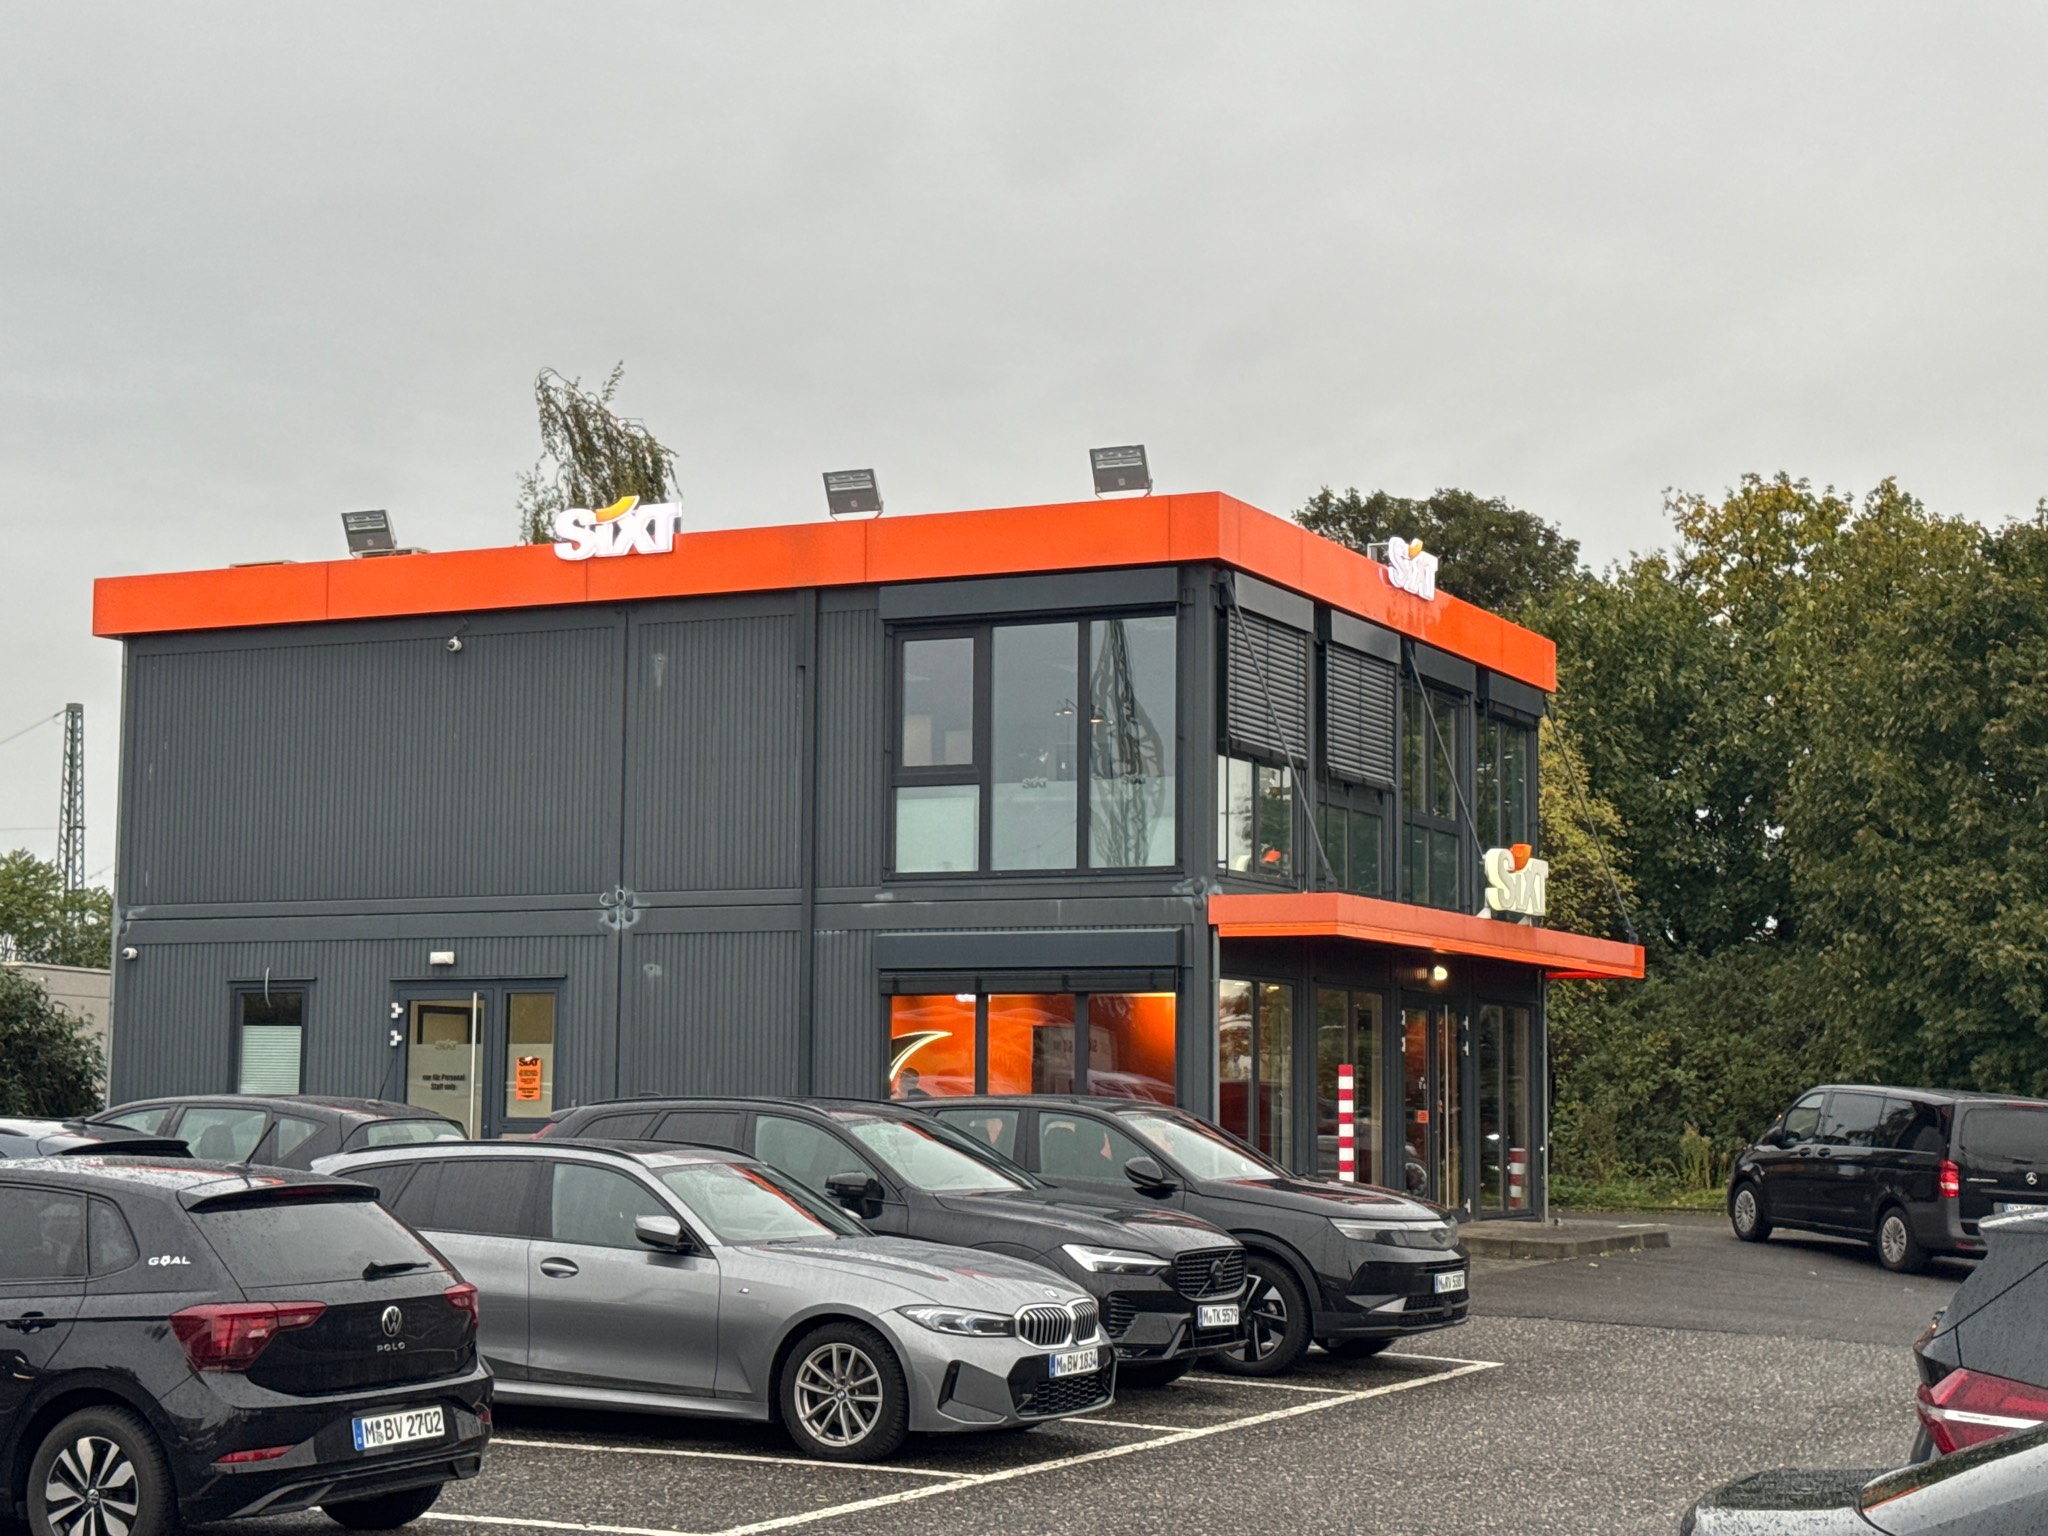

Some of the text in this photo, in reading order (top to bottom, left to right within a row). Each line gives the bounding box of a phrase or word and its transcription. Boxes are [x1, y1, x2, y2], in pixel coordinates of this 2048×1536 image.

[148, 1255, 191, 1267] GOAL
[376, 1341, 406, 1352] POLO
[364, 1410, 443, 1444] M BV 2702
